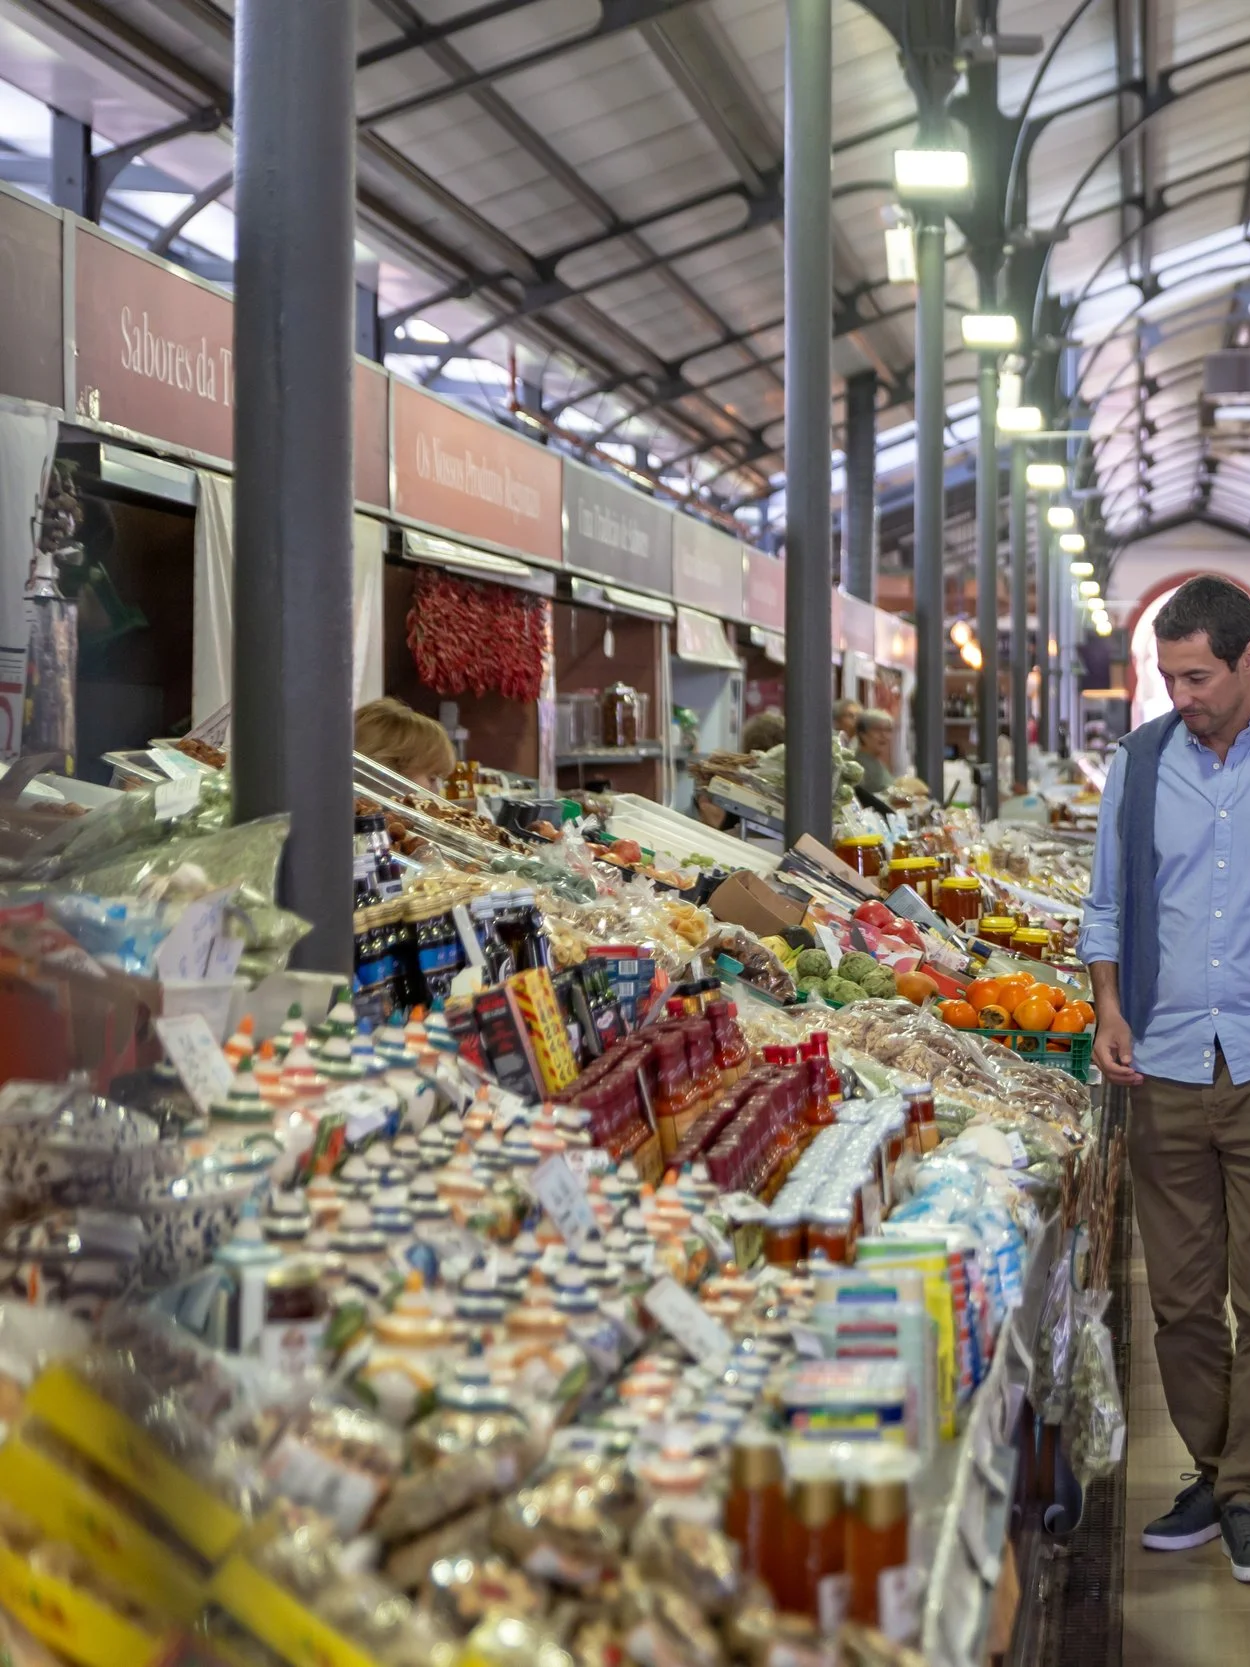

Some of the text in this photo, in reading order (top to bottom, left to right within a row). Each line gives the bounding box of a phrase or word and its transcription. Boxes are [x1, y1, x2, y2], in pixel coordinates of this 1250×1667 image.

[121, 305, 193, 392] Sabores
[196, 336, 216, 402] da
[416, 431, 430, 481] Os
